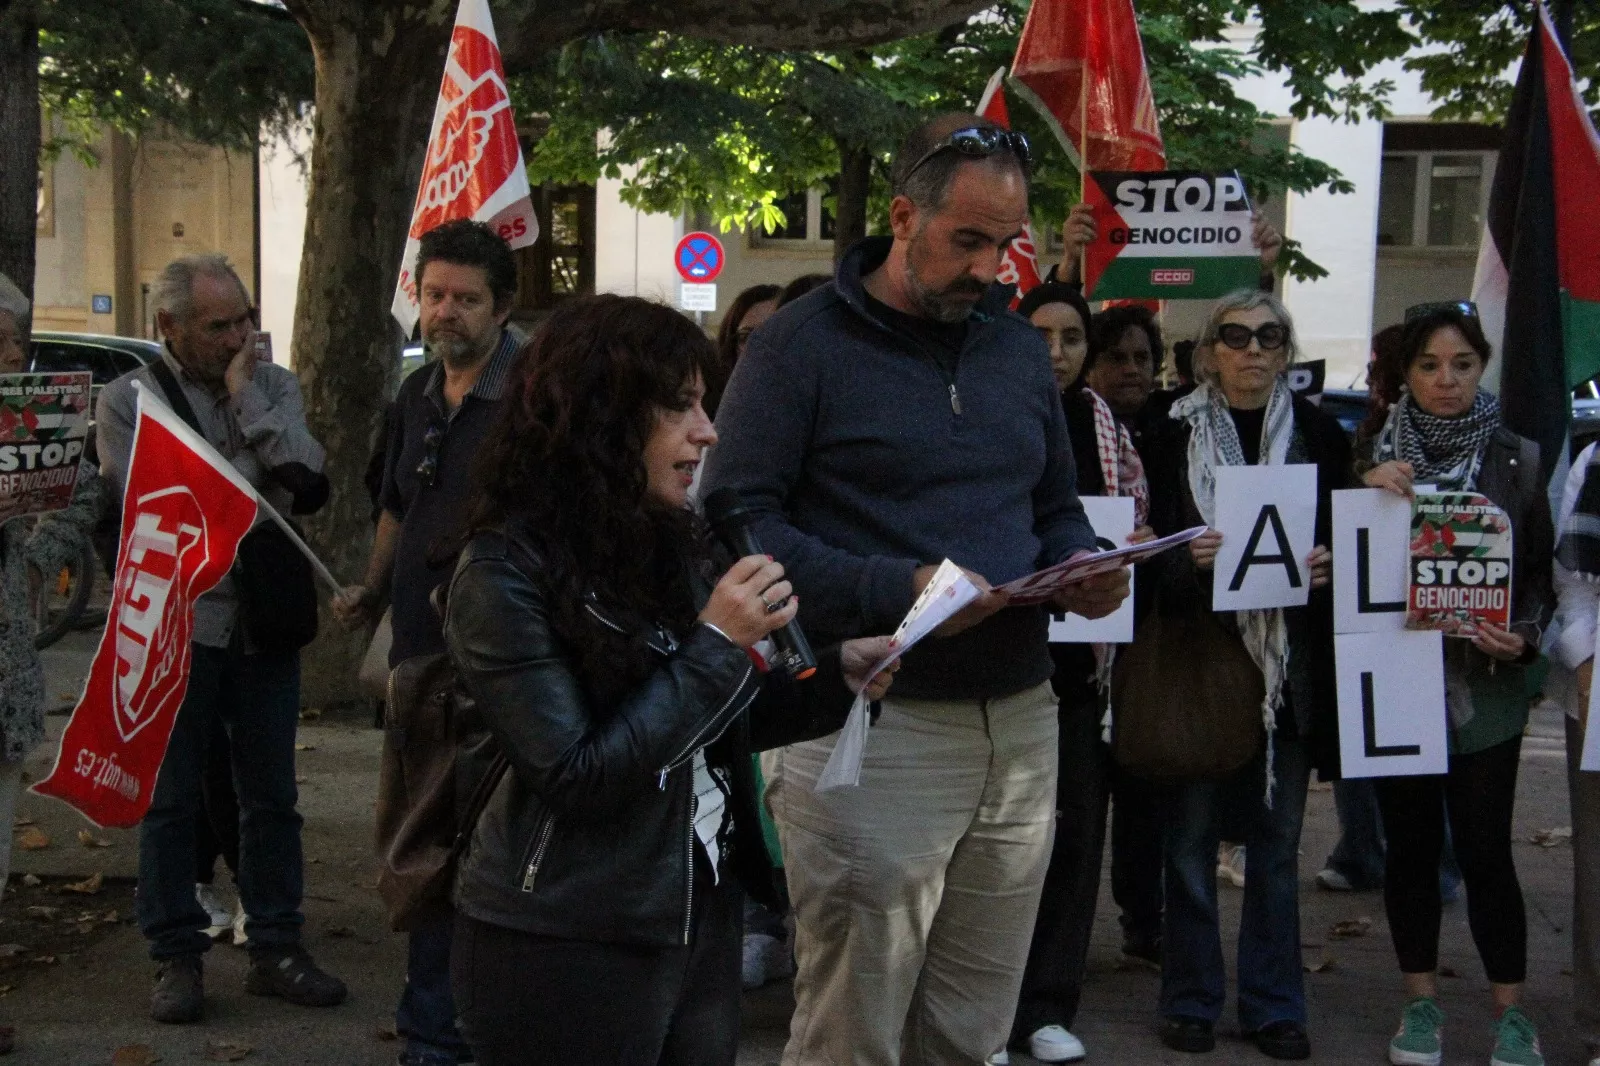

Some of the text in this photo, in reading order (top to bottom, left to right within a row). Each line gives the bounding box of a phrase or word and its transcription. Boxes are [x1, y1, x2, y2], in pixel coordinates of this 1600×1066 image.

[1115, 177, 1243, 212] STOP
[1109, 227, 1241, 244] GENOCIDIO
[0, 441, 83, 472] STOP
[0, 466, 75, 494] GENOCIDIO
[1417, 504, 1444, 514] FREE
[1228, 505, 1302, 591] A
[1357, 528, 1406, 614] L
[1416, 560, 1509, 585] STOP
[1416, 587, 1505, 610] GENOCIDIO
[1361, 672, 1420, 758] L
